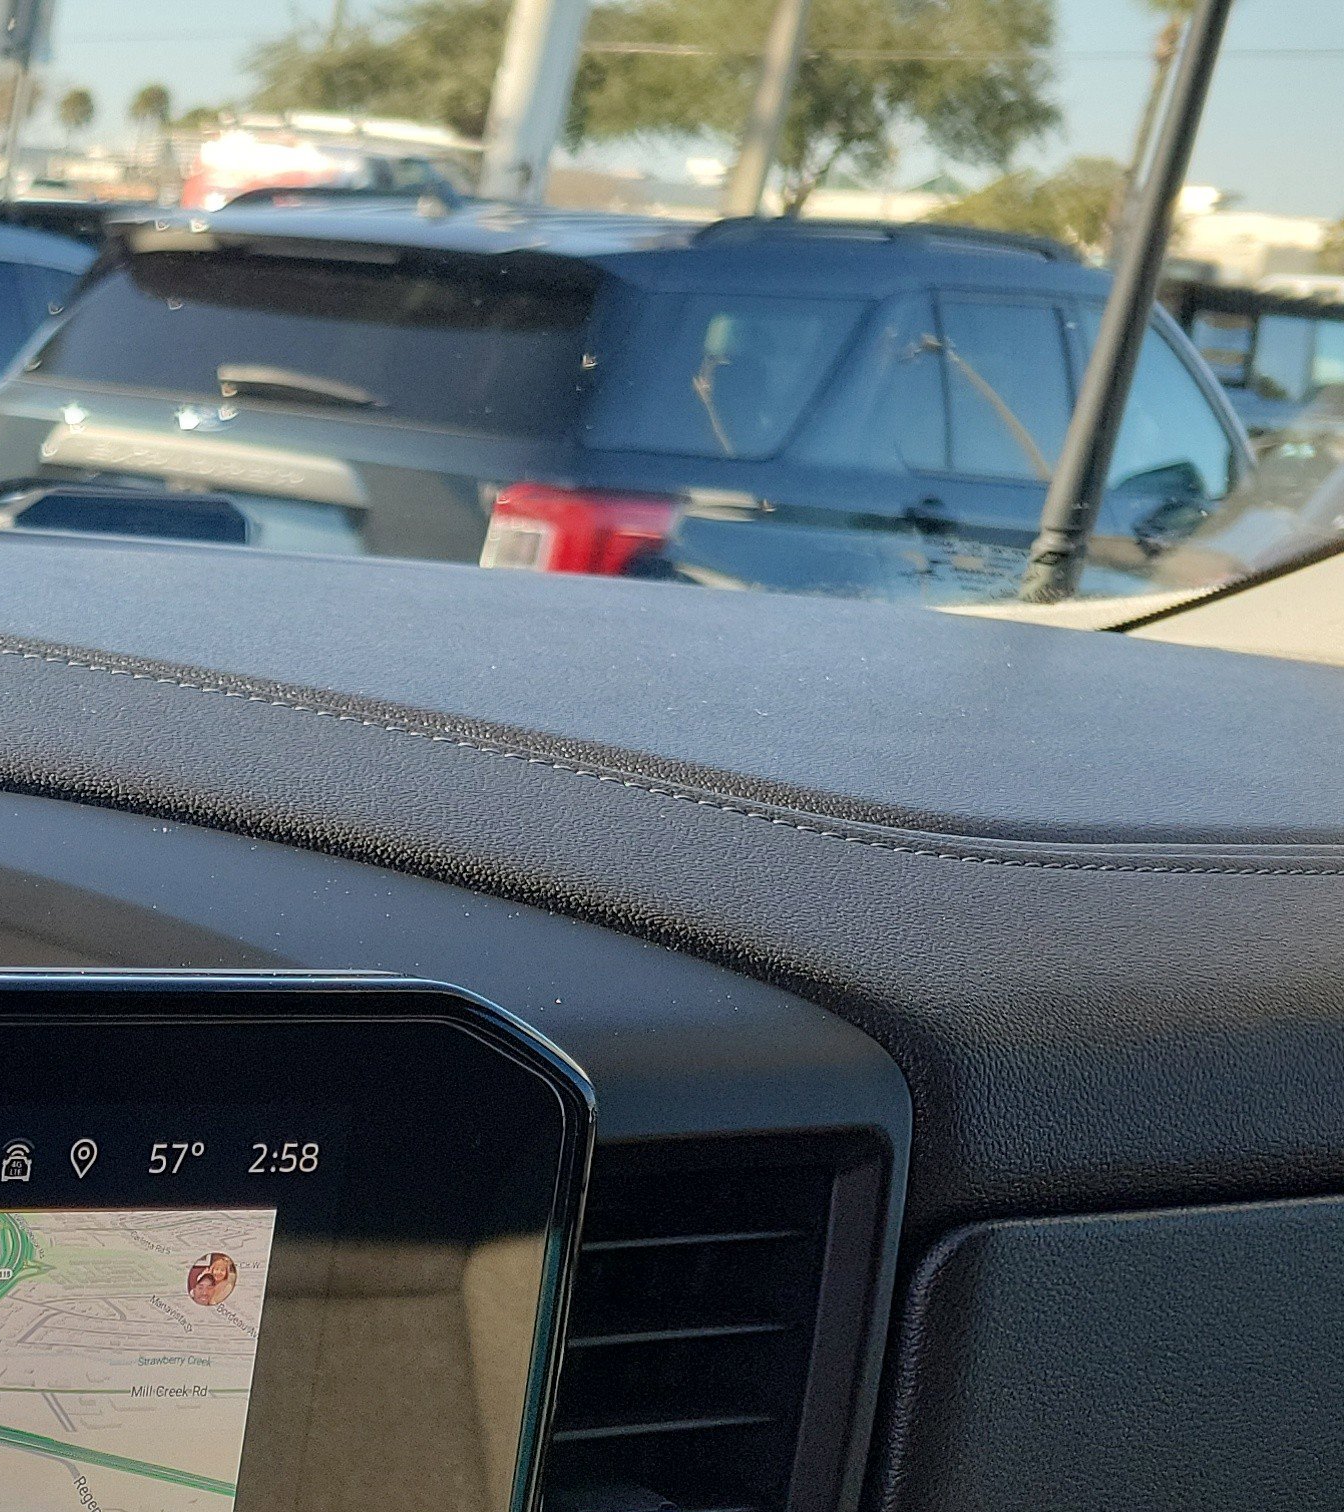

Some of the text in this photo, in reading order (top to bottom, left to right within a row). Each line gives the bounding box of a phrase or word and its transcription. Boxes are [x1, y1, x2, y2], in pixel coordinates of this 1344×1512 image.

[10, 1160, 23, 1168] 4G
[148, 1141, 205, 1174] 57°
[248, 1142, 320, 1174] 2:58
[137, 1355, 211, 1369] Strawberry Creek
[130, 1385, 208, 1398] Mill Creek Rd
